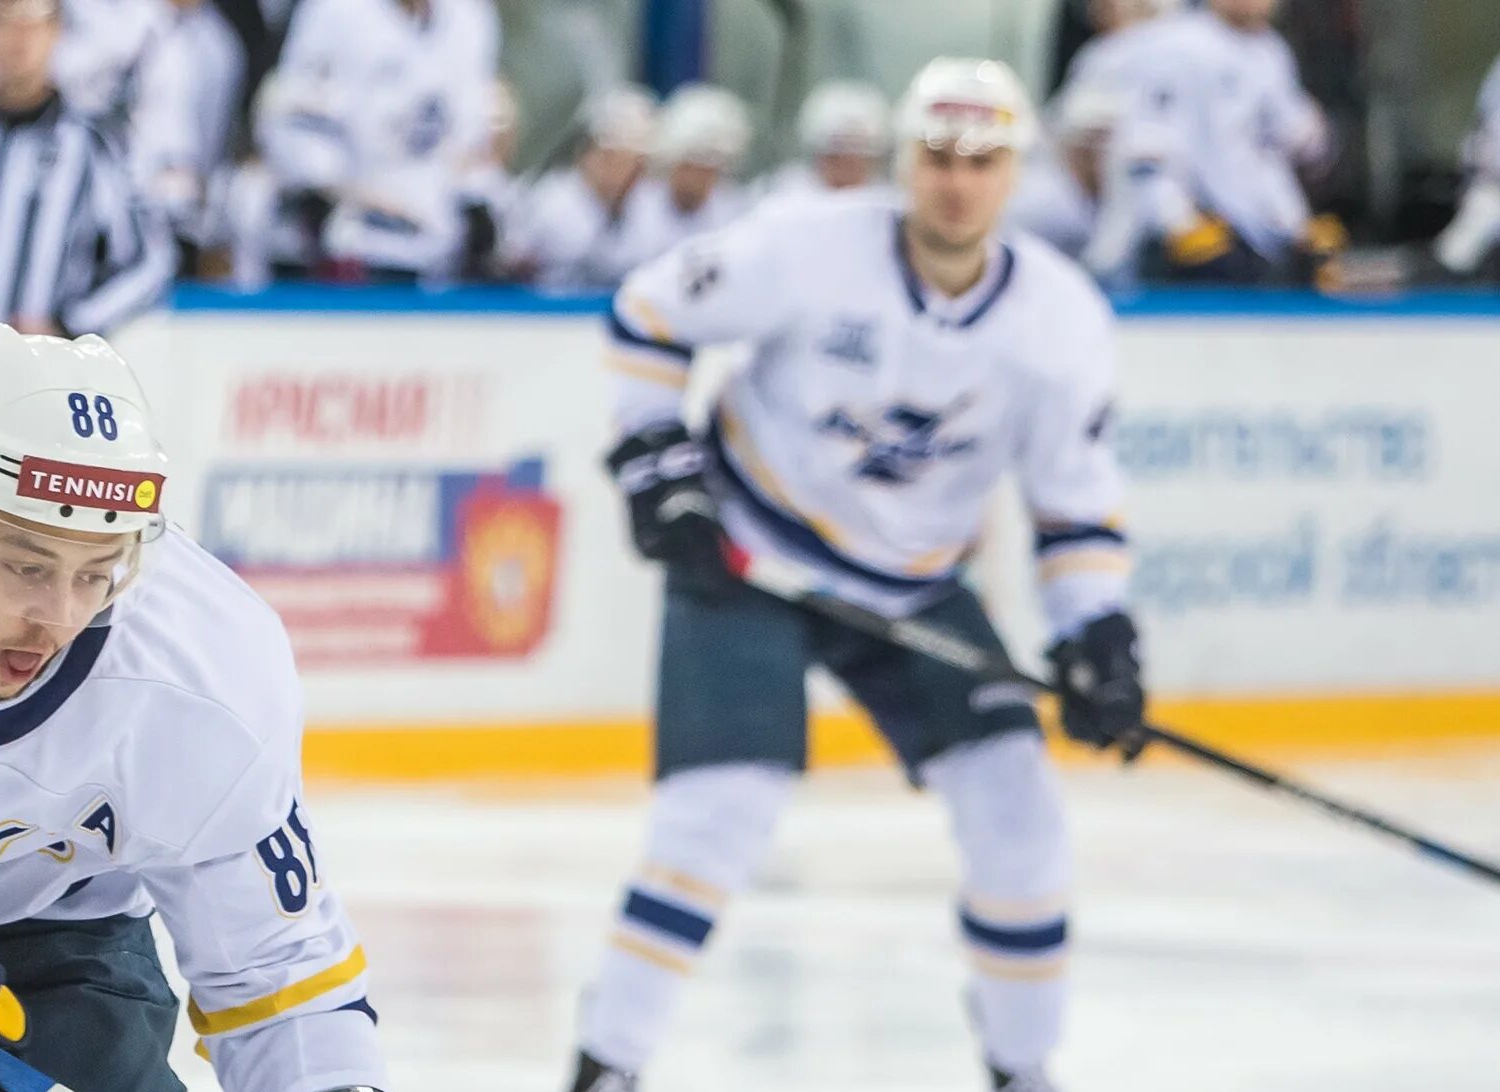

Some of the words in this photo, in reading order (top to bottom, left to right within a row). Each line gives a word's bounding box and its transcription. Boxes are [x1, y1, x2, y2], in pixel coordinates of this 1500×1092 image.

[67, 392, 118, 441] 88
[30, 470, 134, 503] TENNISI
[78, 801, 116, 856] A
